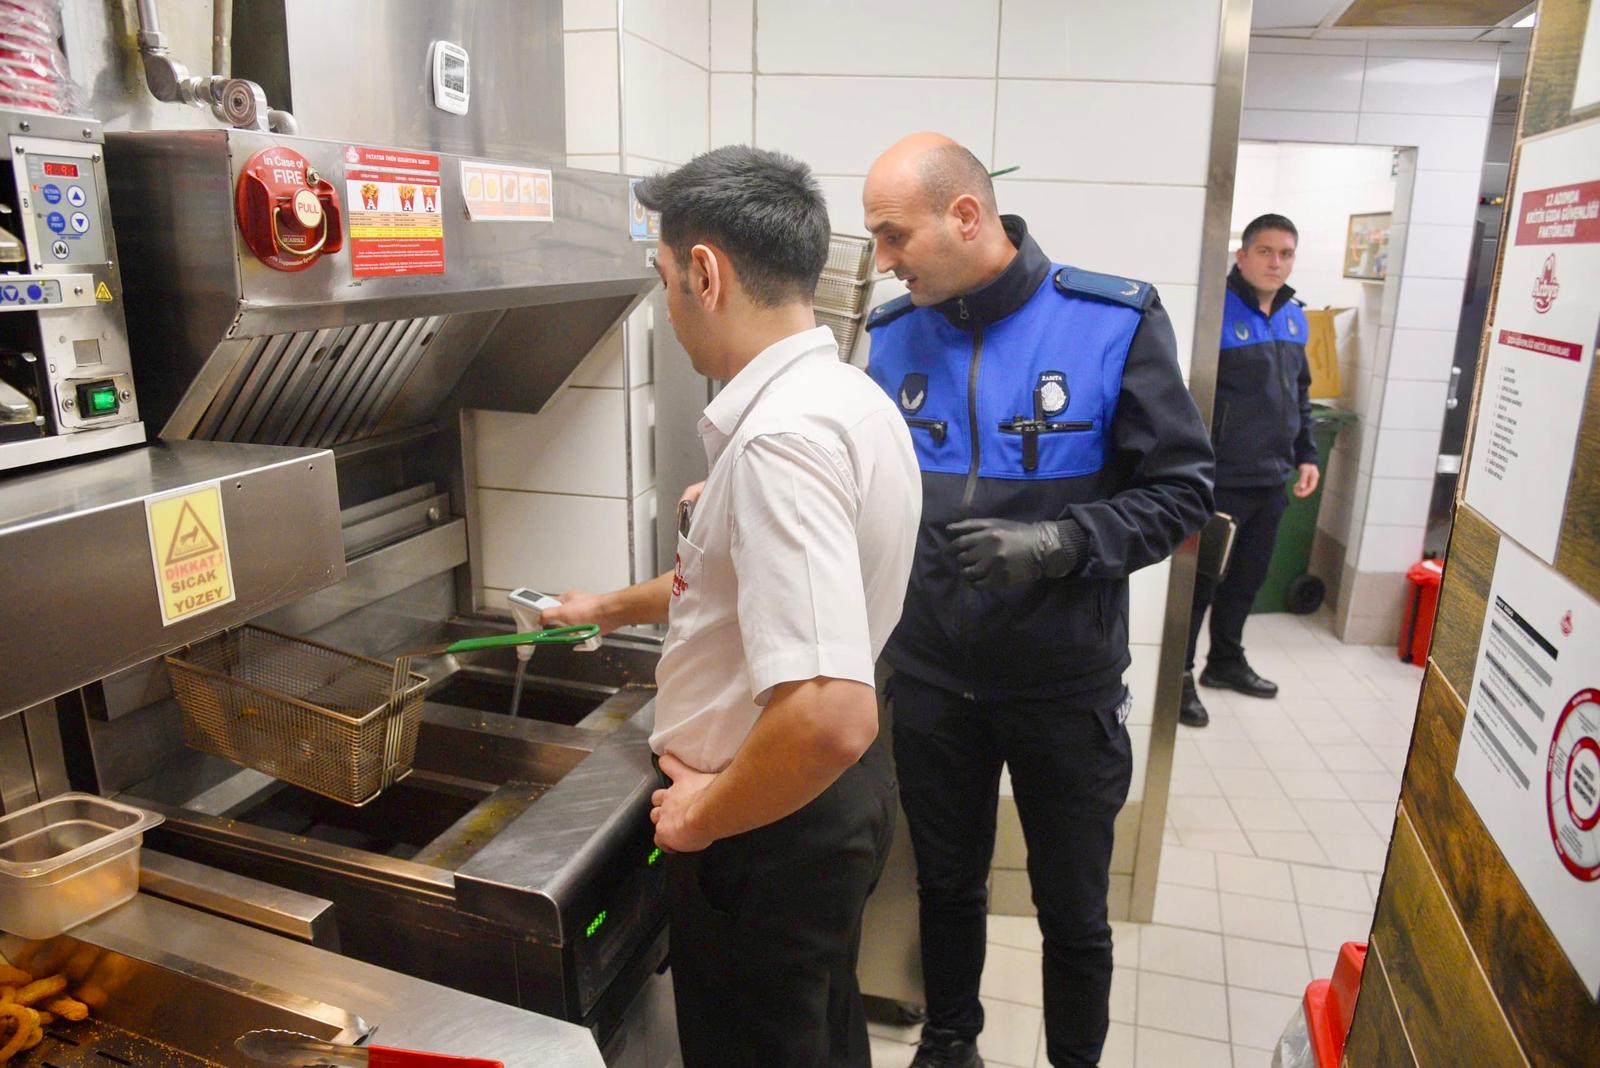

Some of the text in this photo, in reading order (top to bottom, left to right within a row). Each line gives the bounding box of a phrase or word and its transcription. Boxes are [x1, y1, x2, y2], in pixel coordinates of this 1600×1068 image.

[263, 155, 304, 168] In Case of
[273, 169, 304, 185] FIRE
[298, 202, 319, 214] PULL
[165, 555, 216, 581] DİKKAT
[171, 569, 217, 594] SICAK
[174, 586, 223, 613] YÜZEY
